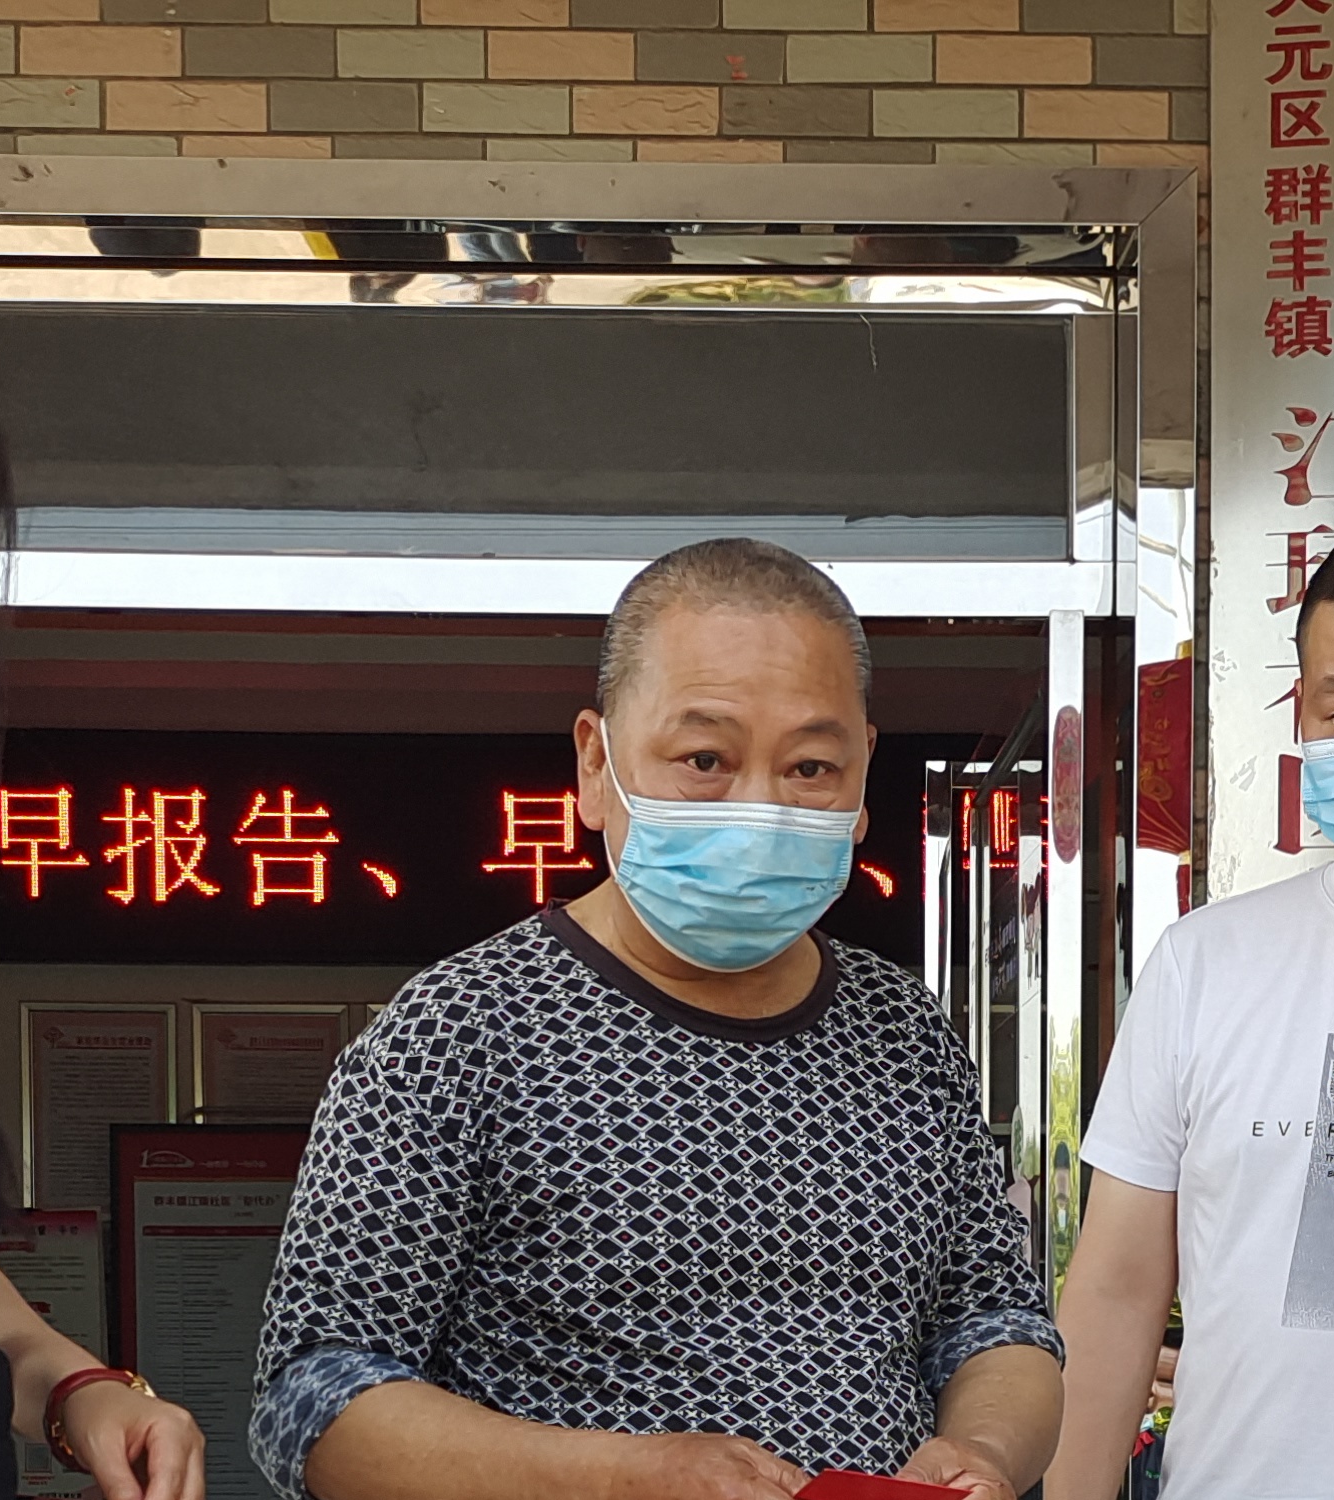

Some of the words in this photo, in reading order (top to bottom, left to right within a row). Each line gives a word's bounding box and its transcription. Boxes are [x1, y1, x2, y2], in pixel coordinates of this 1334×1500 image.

[1264, 0, 1334, 360] 元区群丰镇
